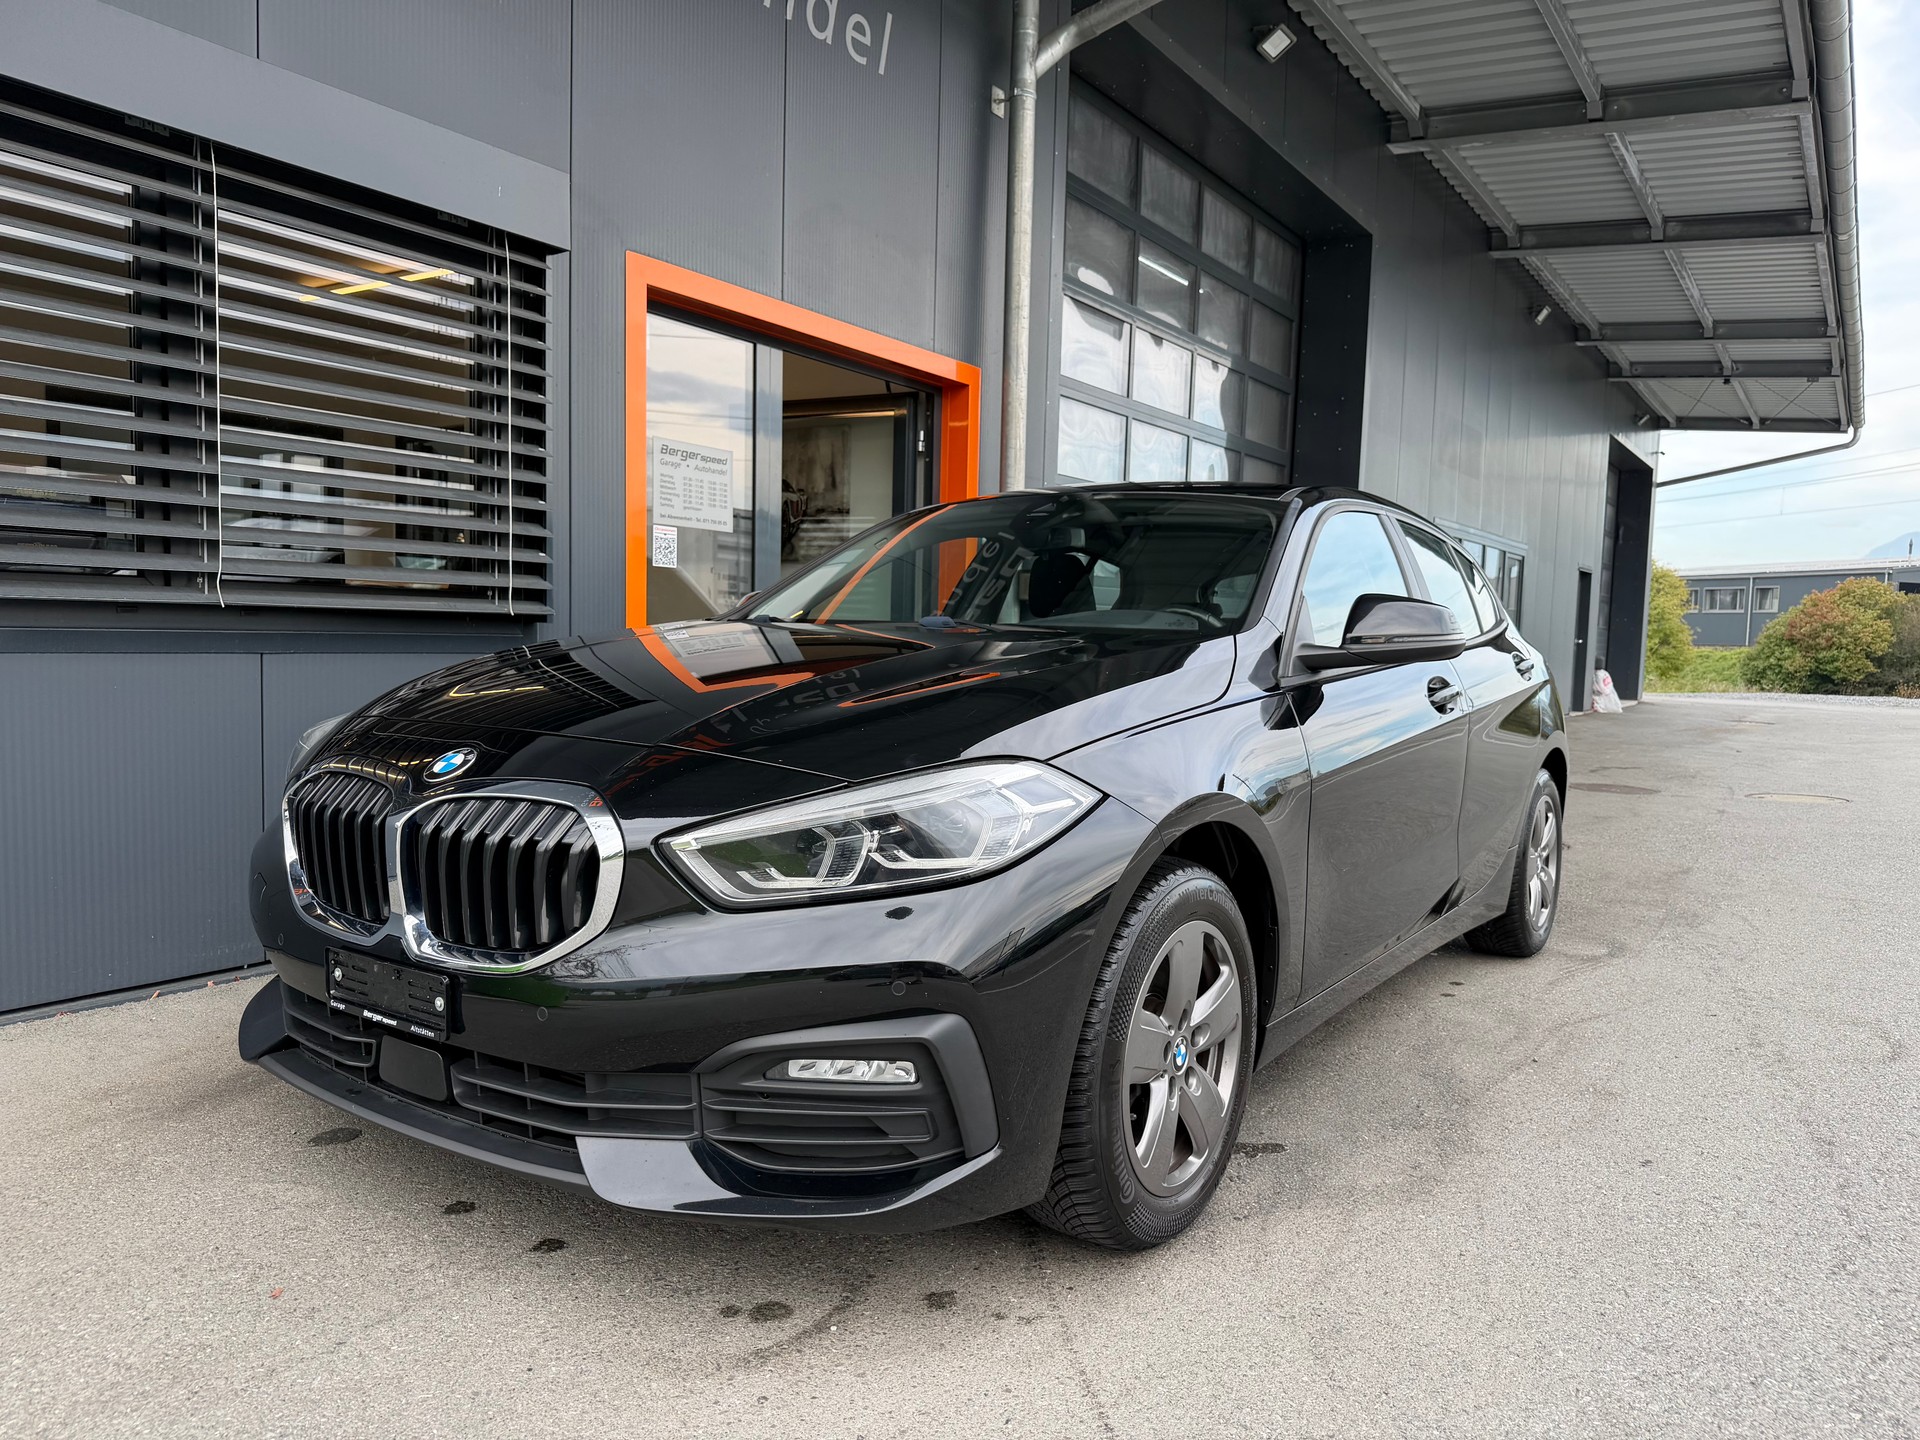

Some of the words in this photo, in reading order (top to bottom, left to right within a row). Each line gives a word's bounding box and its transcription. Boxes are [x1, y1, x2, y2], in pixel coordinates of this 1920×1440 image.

[660, 444, 728, 466] Bergerspeed
[660, 458, 681, 469] Garage
[694, 464, 728, 476] Autohandel
[330, 999, 346, 1010] Garage
